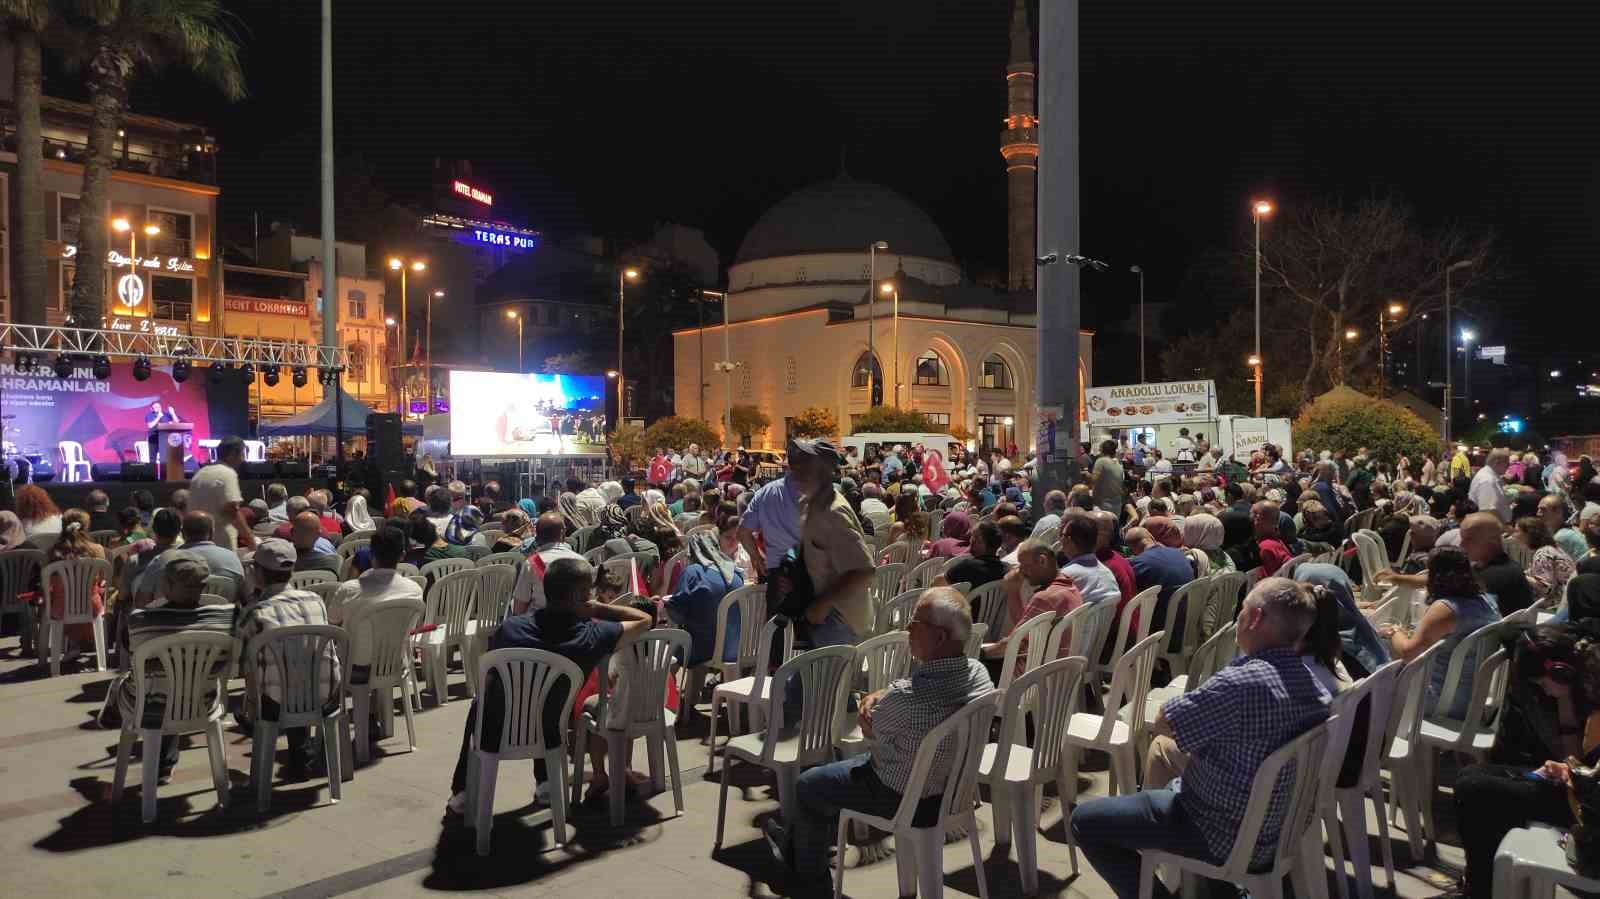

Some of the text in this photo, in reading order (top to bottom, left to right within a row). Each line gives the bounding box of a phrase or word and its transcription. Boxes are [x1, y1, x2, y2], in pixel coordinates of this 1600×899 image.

[454, 180, 471, 198] HOTEL
[475, 230, 511, 246] TERAS
[0, 377, 111, 393] HRAMANLARI
[1110, 383, 1206, 399] ANADOLU LOKMA
